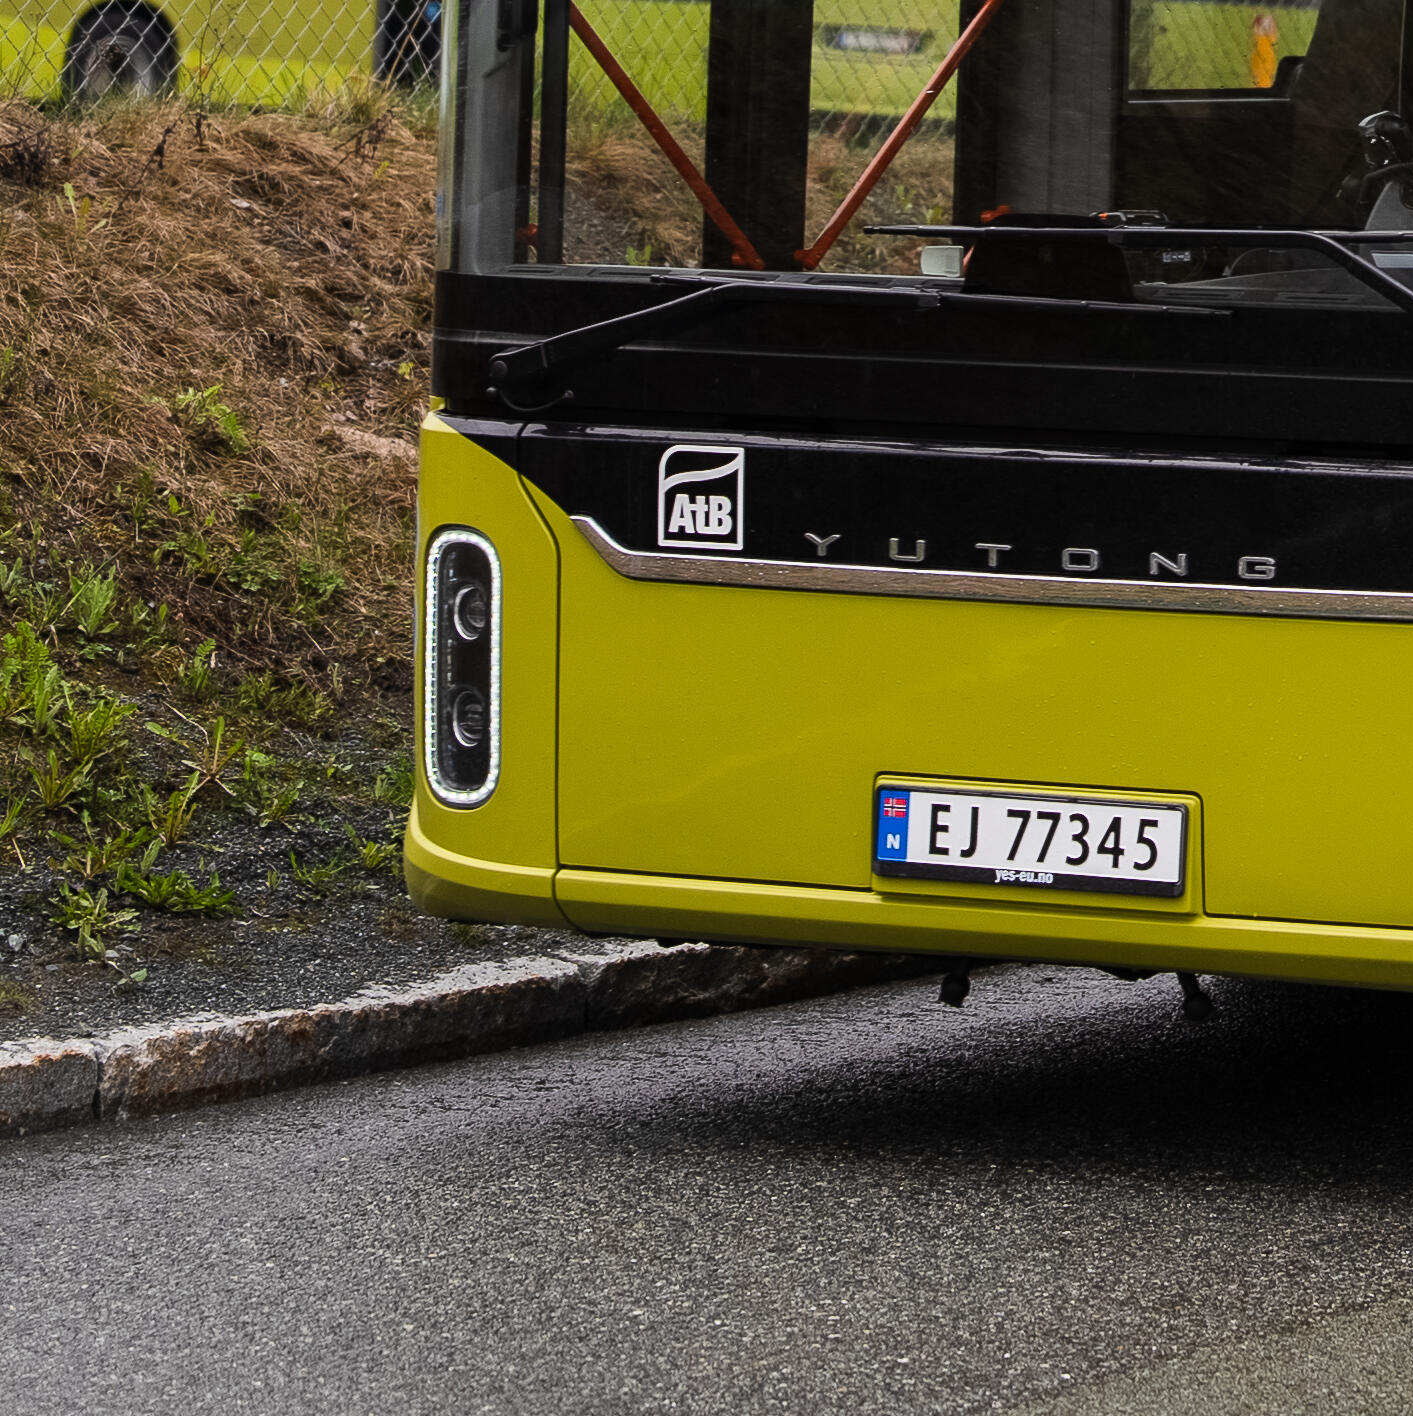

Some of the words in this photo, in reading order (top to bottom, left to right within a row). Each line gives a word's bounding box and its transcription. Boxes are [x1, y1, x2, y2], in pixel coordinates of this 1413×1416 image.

[668, 492, 733, 536] AtB
[886, 833, 901, 851] N
[928, 803, 980, 859] EJ
[1006, 808, 1160, 872] 77345
[994, 868, 1054, 884] yes-eu.no
